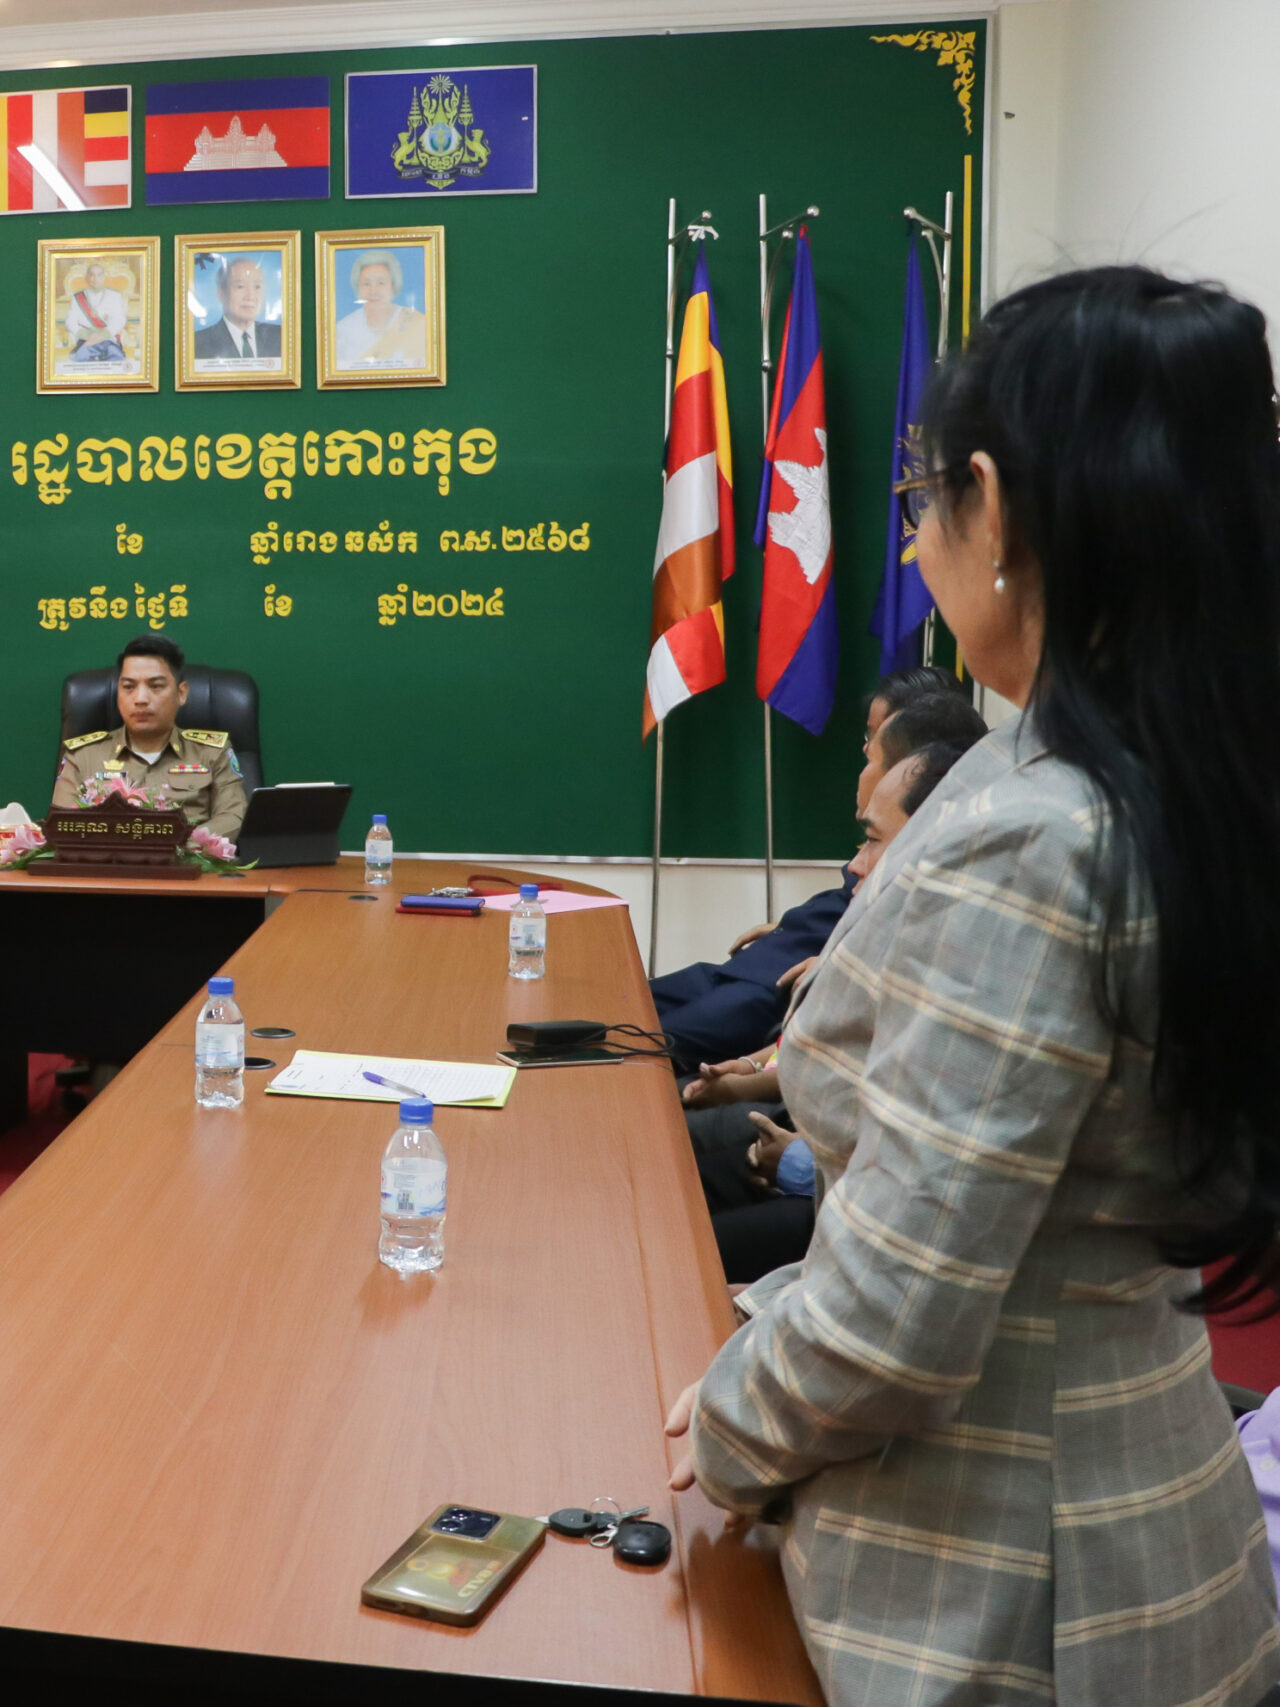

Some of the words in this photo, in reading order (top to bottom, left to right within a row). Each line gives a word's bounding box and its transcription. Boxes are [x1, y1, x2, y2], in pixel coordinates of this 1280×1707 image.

[11, 427, 498, 505] រដ្ឋបាលខេត្តកោះកុង
[115, 523, 144, 555] ខែ
[264, 583, 293, 617] ខែ
